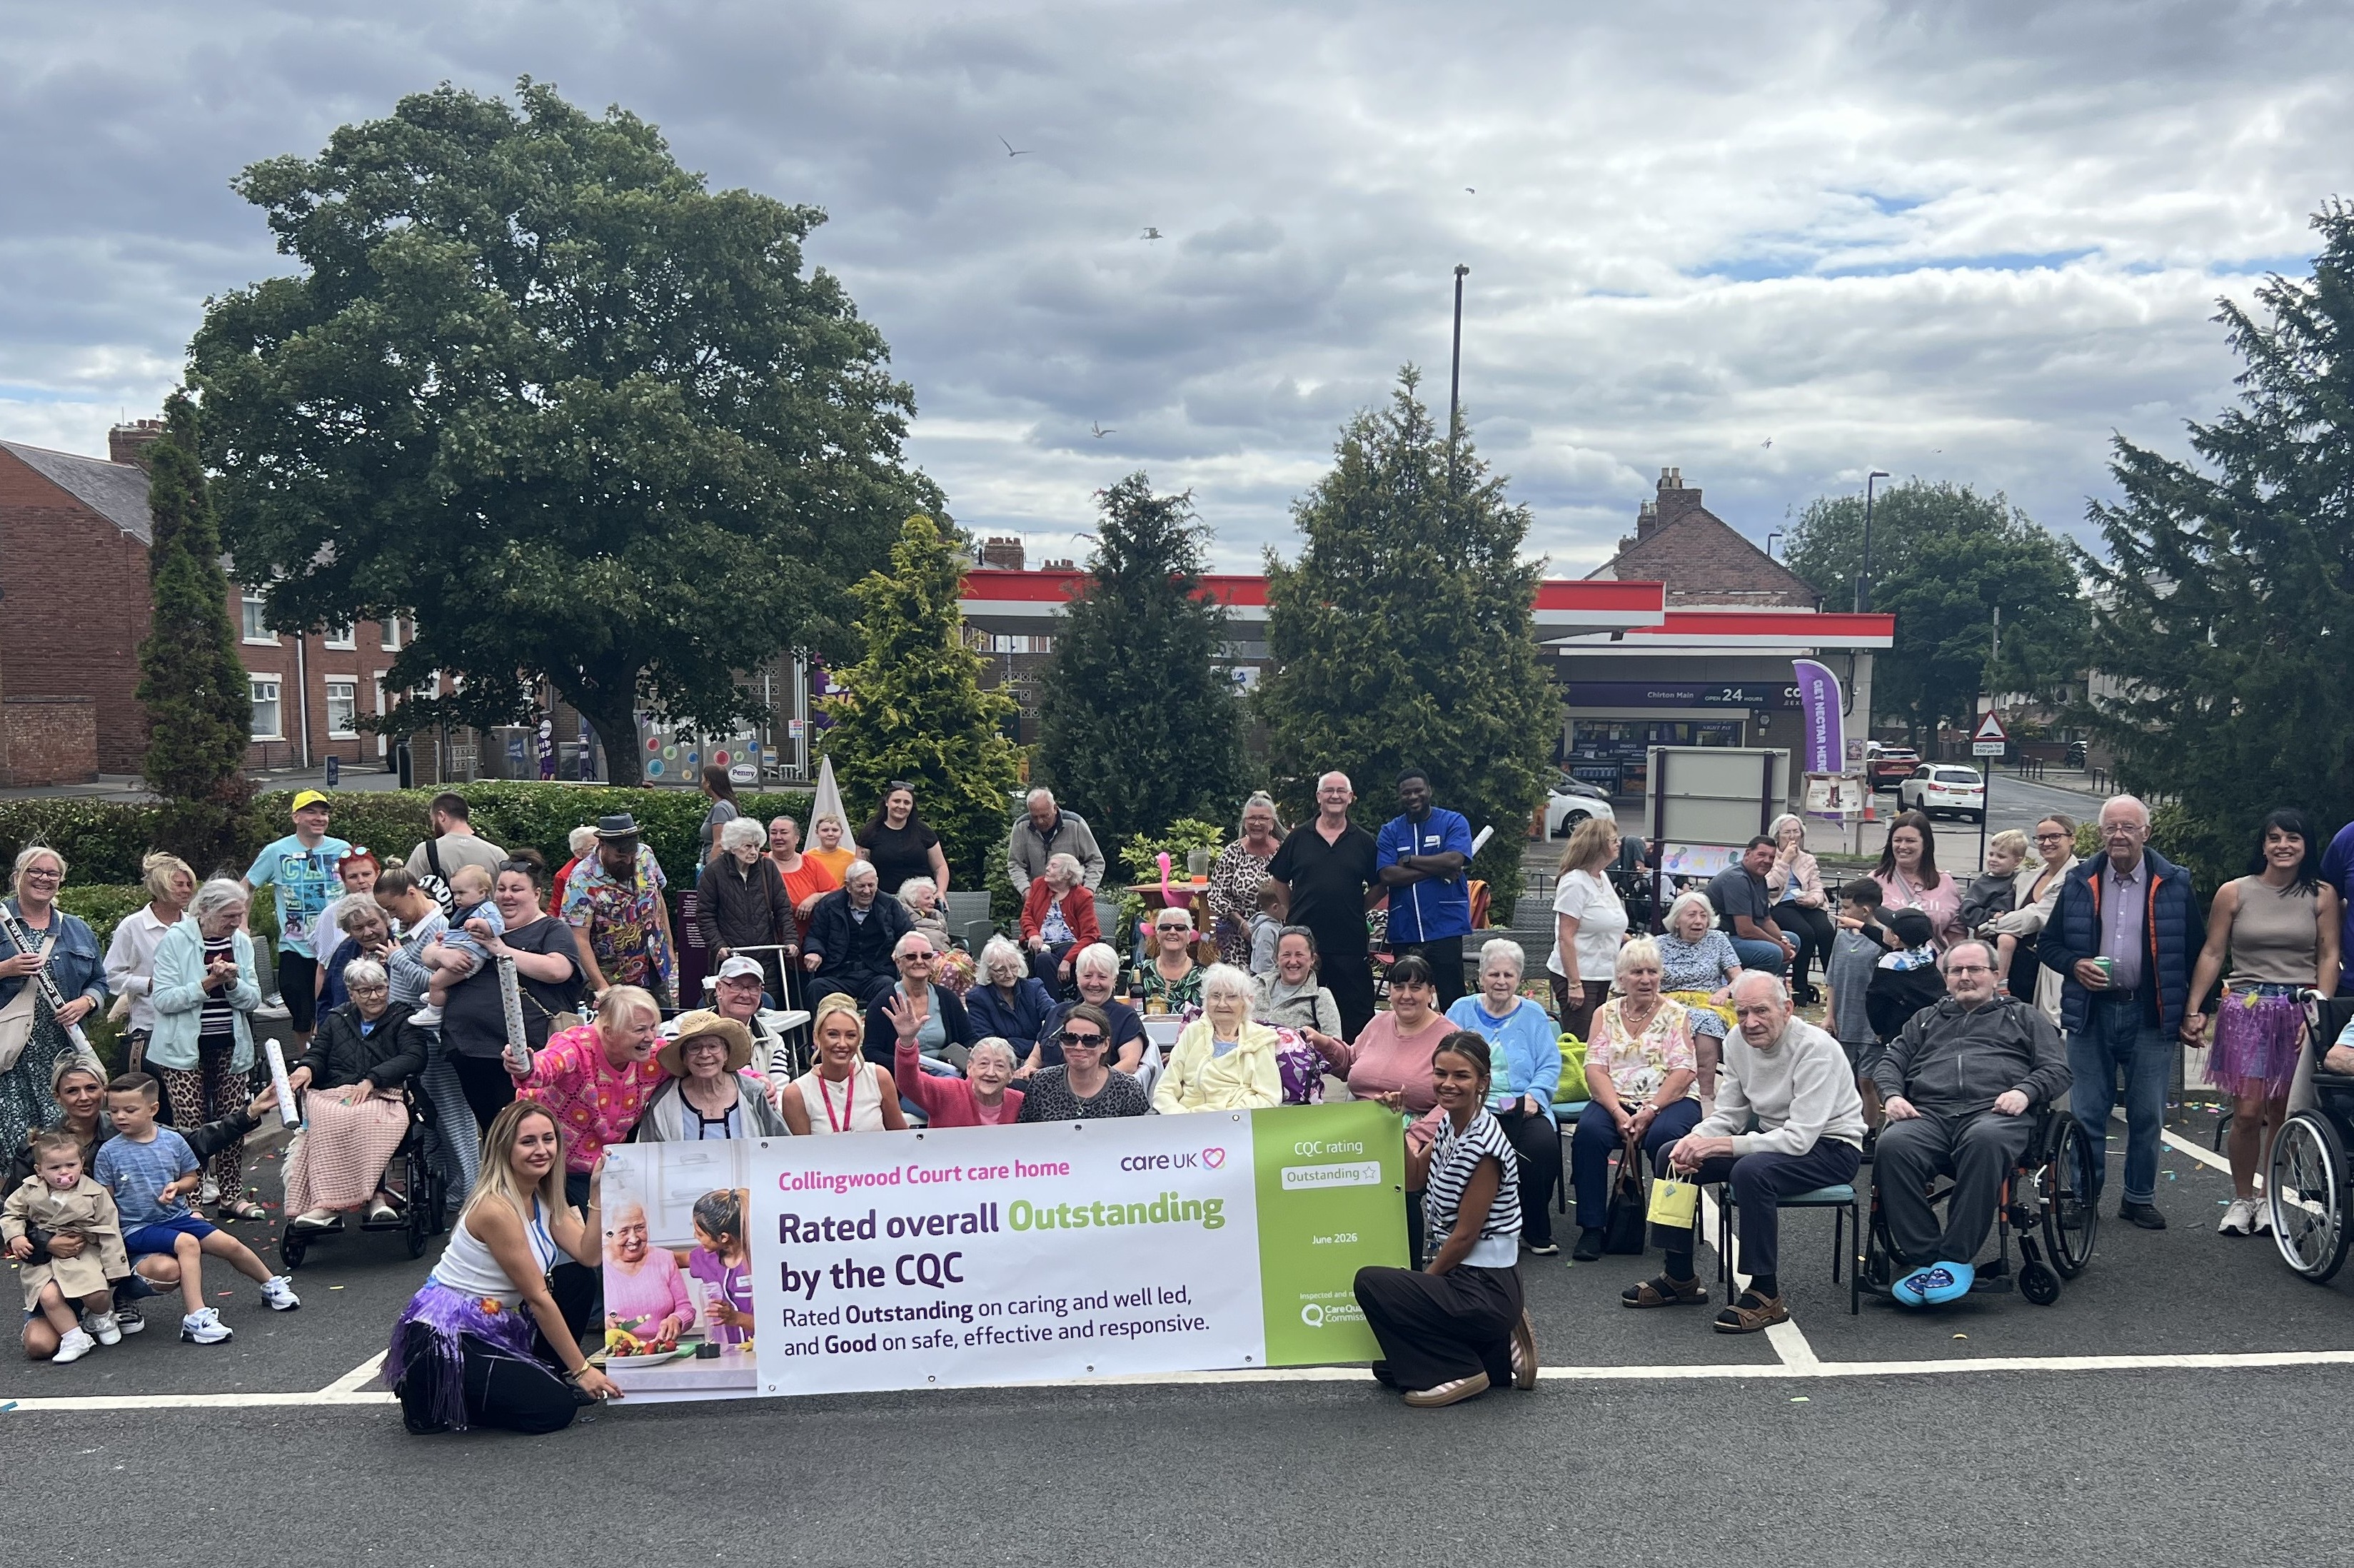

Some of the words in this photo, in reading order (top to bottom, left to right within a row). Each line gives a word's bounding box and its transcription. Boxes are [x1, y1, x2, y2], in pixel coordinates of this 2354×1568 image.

[1723, 688, 1743, 702] 24
[1814, 679, 1824, 700] GET
[1815, 702, 1827, 744] NECTAR
[1816, 745, 1828, 773] HERE
[1294, 1141, 1323, 1157] CQC
[1327, 1140, 1363, 1154] rating
[1121, 1155, 1170, 1171] care
[1174, 1153, 1198, 1168] UK
[779, 1167, 901, 1194] Collingwood
[907, 1165, 962, 1184] Court
[967, 1165, 1009, 1180] care
[1015, 1160, 1070, 1177] home
[1287, 1168, 1359, 1182] Outstanding
[780, 1209, 876, 1244] Rated
[887, 1202, 999, 1238] overall
[1009, 1191, 1225, 1231] Outstanding
[1312, 1235, 1332, 1245] June
[1334, 1233, 1358, 1243] 2026
[781, 1262, 821, 1300] by
[830, 1258, 885, 1290] the
[895, 1252, 964, 1289] CQC
[783, 1306, 840, 1327] Rated
[846, 1301, 974, 1323] Outstanding
[978, 1302, 1002, 1317] on
[1007, 1295, 1068, 1317] caring
[1072, 1290, 1107, 1310] and
[1113, 1287, 1152, 1307] well
[1158, 1285, 1192, 1305] led,
[1300, 1291, 1332, 1300] Inspected
[1325, 1313, 1367, 1322] Commissi
[785, 1337, 819, 1356] and
[825, 1333, 877, 1354] Good
[882, 1337, 906, 1350] on
[912, 1329, 958, 1350] safe,
[964, 1325, 1052, 1346] effective
[1058, 1320, 1094, 1340] and
[1100, 1314, 1210, 1340] responsive.
